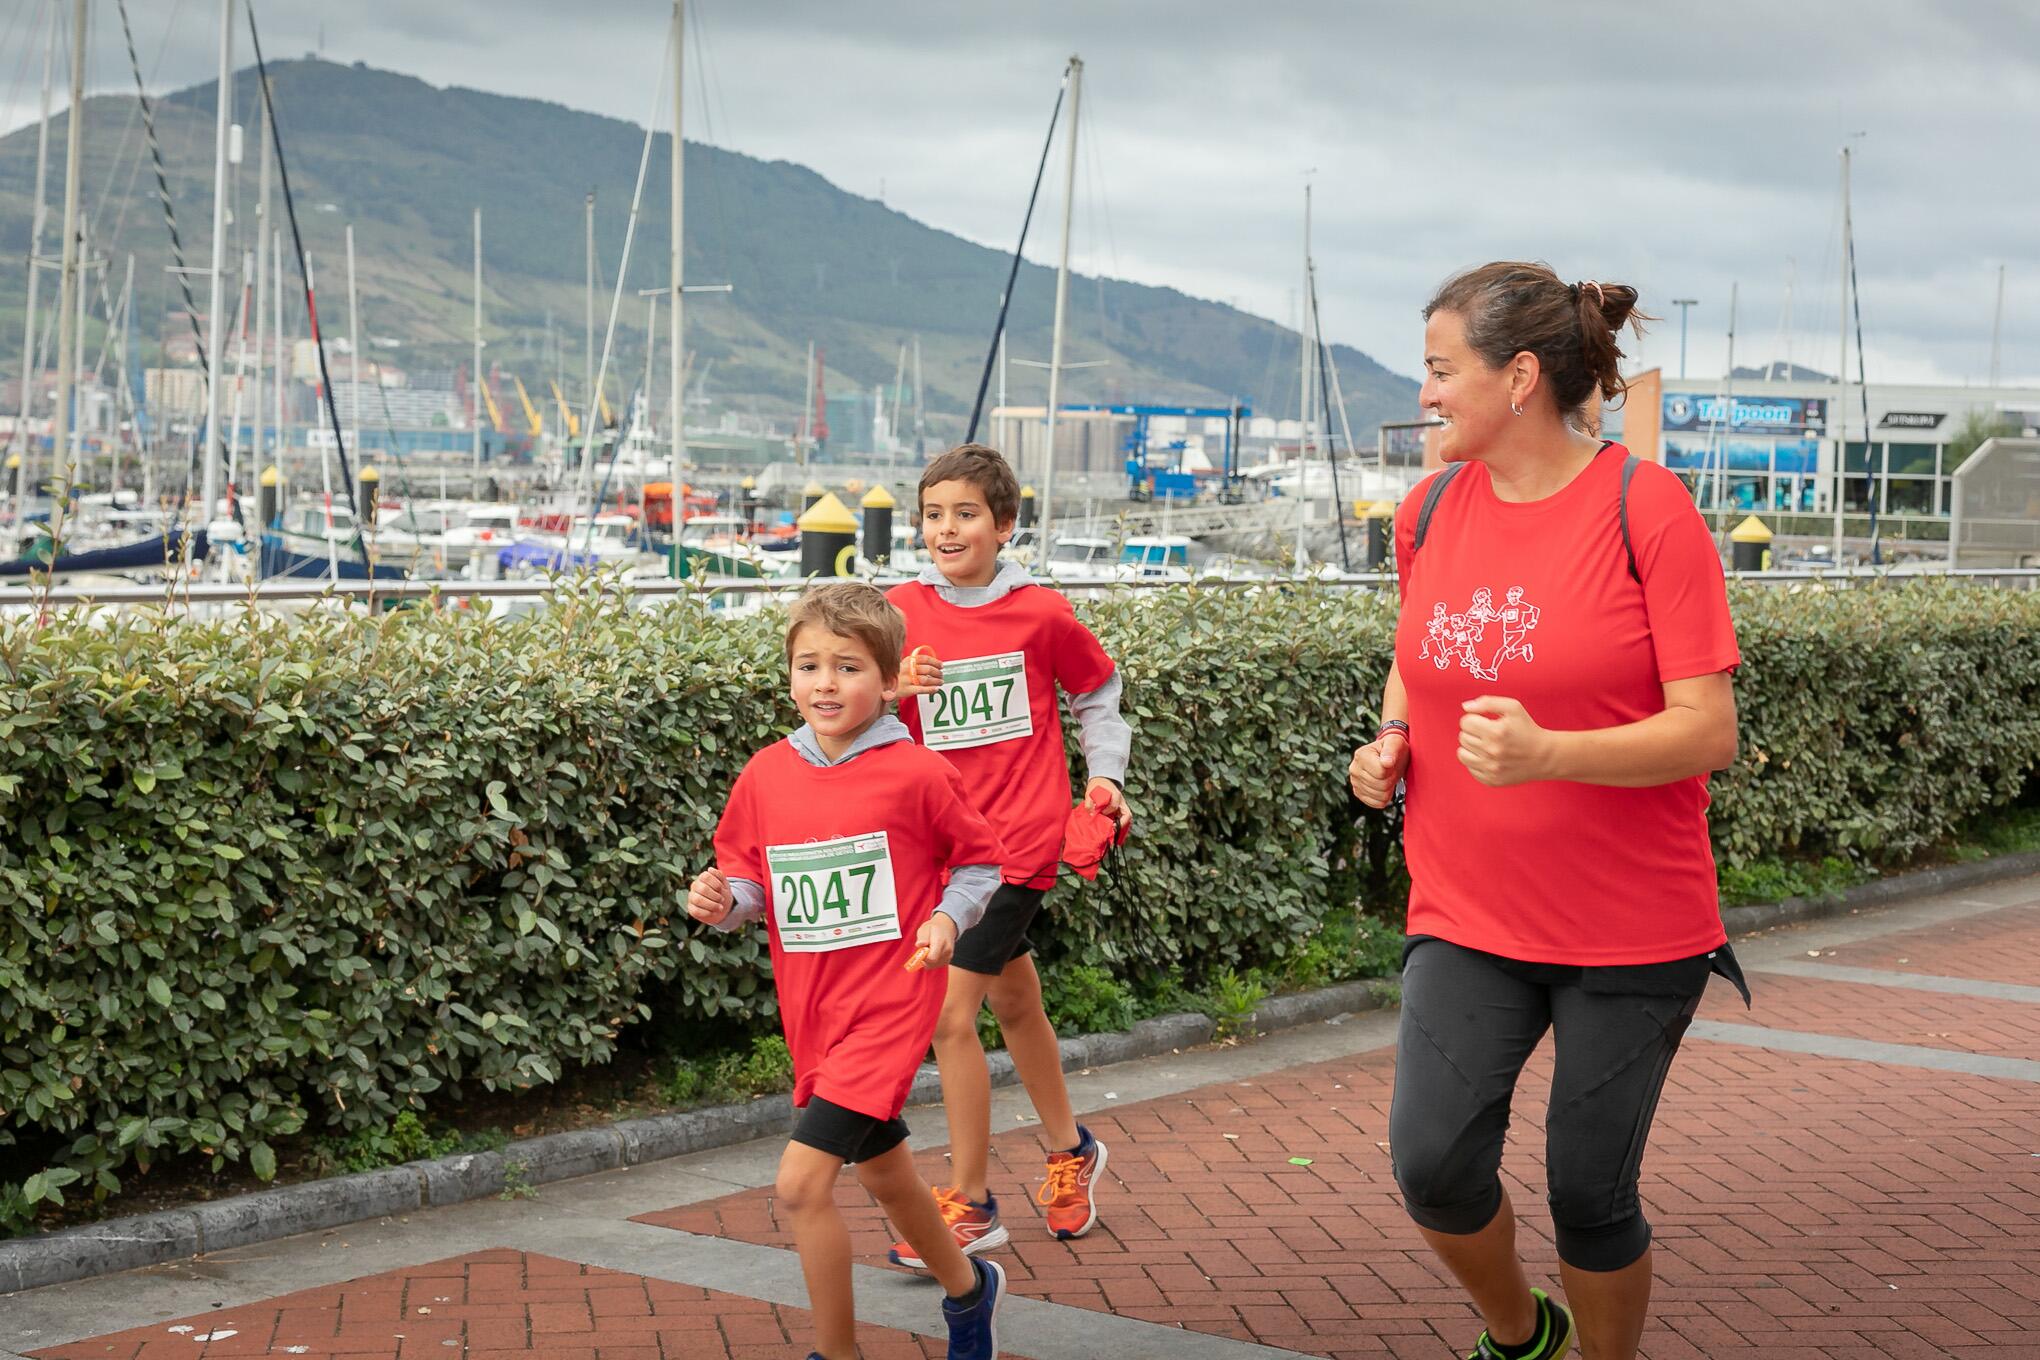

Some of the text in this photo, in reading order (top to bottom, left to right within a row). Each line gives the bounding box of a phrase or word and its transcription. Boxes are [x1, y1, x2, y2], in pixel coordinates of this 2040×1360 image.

[1698, 399, 1791, 425] Tapoon
[929, 678, 1014, 727] 2047
[781, 864, 876, 924] 2047
